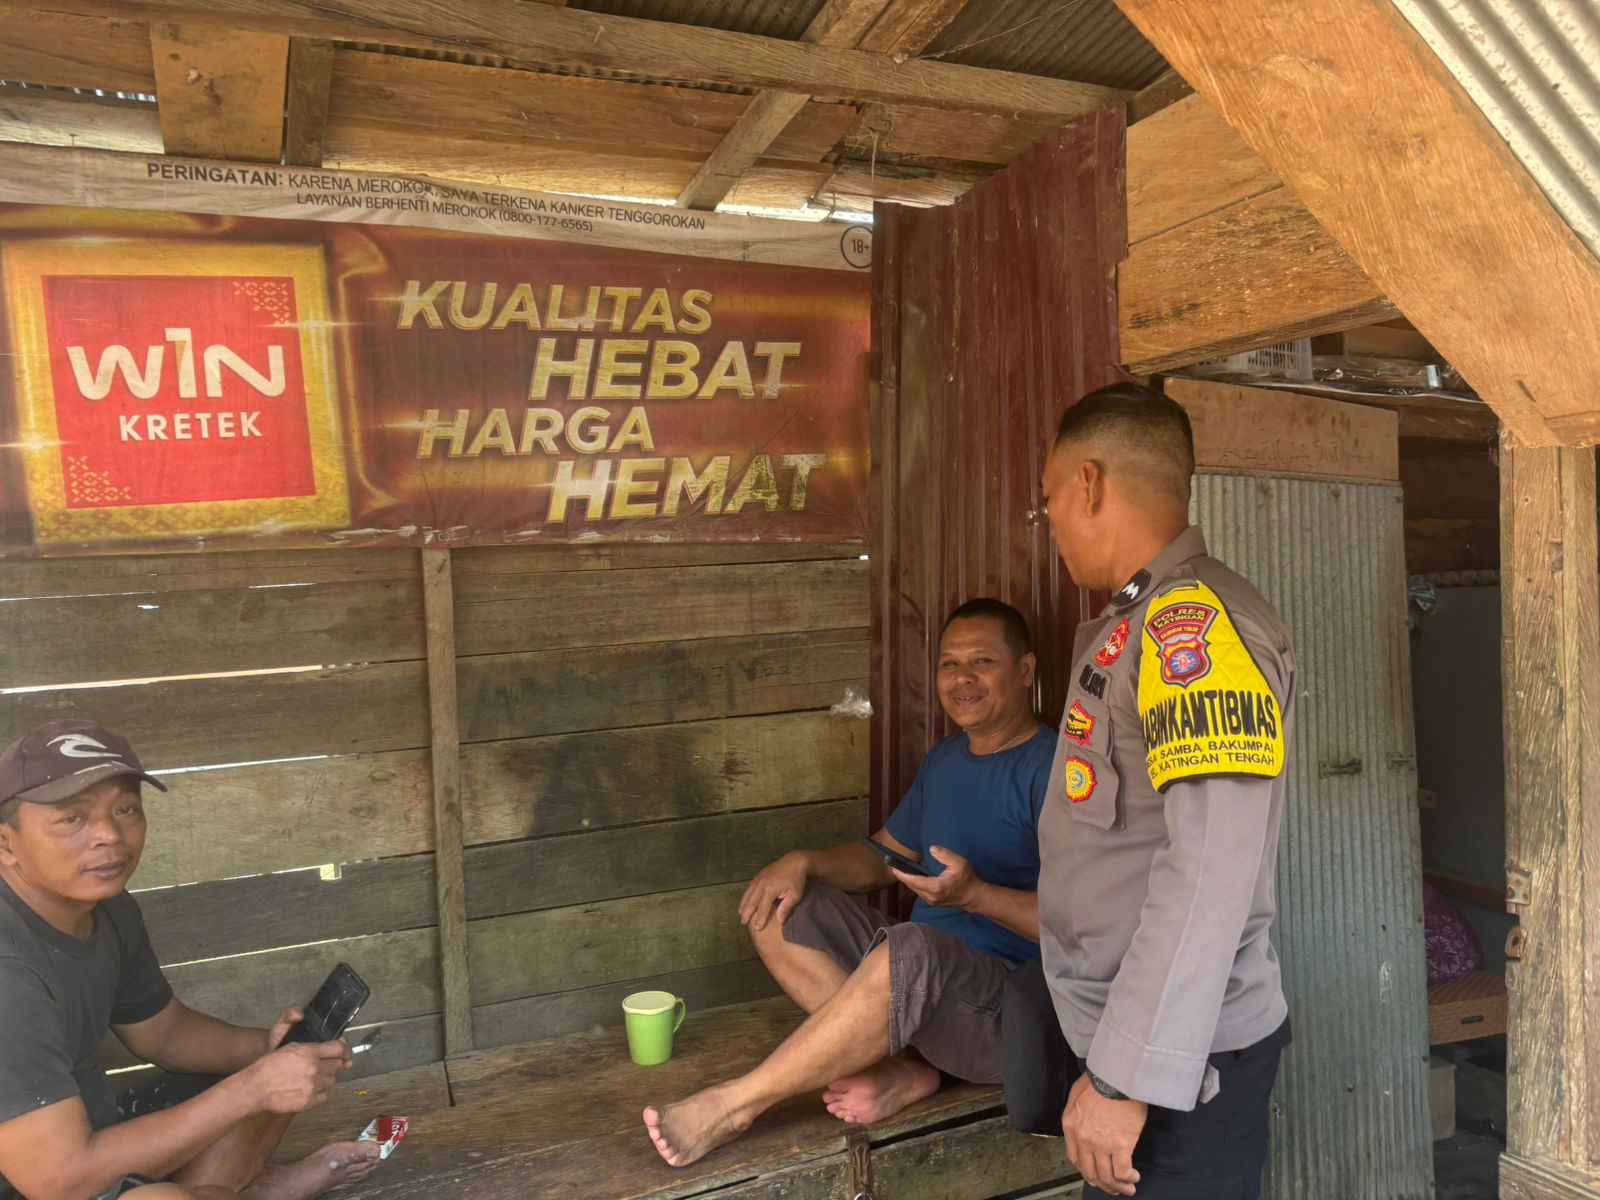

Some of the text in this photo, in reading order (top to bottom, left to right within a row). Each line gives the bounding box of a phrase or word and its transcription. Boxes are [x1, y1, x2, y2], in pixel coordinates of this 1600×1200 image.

[147, 162, 284, 187] PERINGATAN:
[289, 173, 353, 192] KARENA
[441, 187, 480, 204] SAYA
[482, 191, 548, 213] TERKENA
[550, 200, 605, 220] KANKER
[608, 207, 706, 231] TENGGOROKAN
[297, 192, 593, 233] LAYANAN BERHENTI MEROKOK (0800-177-6565)
[851, 239, 870, 254] 18+
[397, 280, 713, 335] KUALITAS
[528, 337, 802, 400] HEBAT
[119, 411, 263, 442] KRETEK
[416, 406, 655, 459] HARGA
[545, 452, 828, 524] HEMAT
[1159, 752, 1275, 773] KATINGAN TENGAH
[1160, 742, 1202, 759] SAMBA
[1208, 740, 1274, 754] BAKUMPAI
